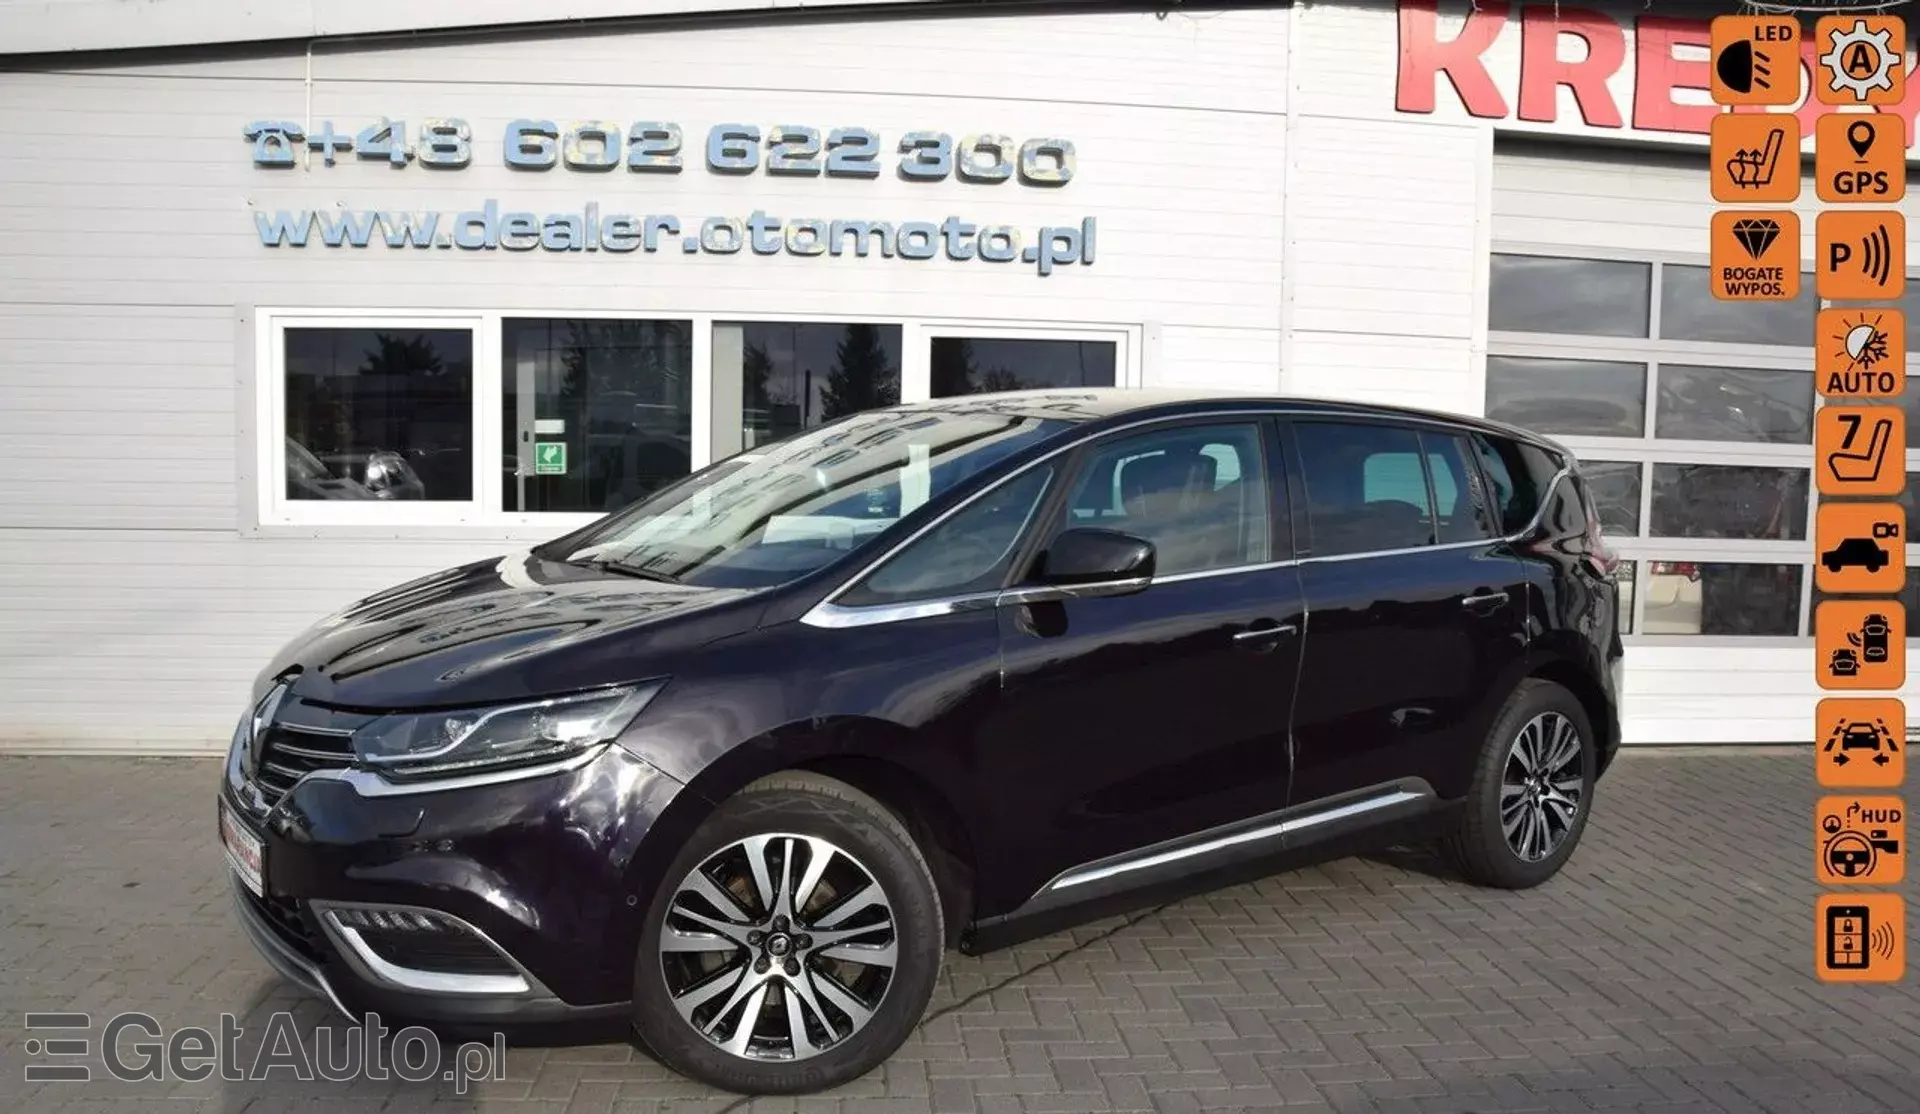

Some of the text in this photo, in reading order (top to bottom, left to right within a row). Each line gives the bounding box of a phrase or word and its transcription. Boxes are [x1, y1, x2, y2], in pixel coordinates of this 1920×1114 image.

[308, 116, 1077, 186] +48 602 622 300
[254, 199, 1097, 275] www.dealer.otomoto.pl
